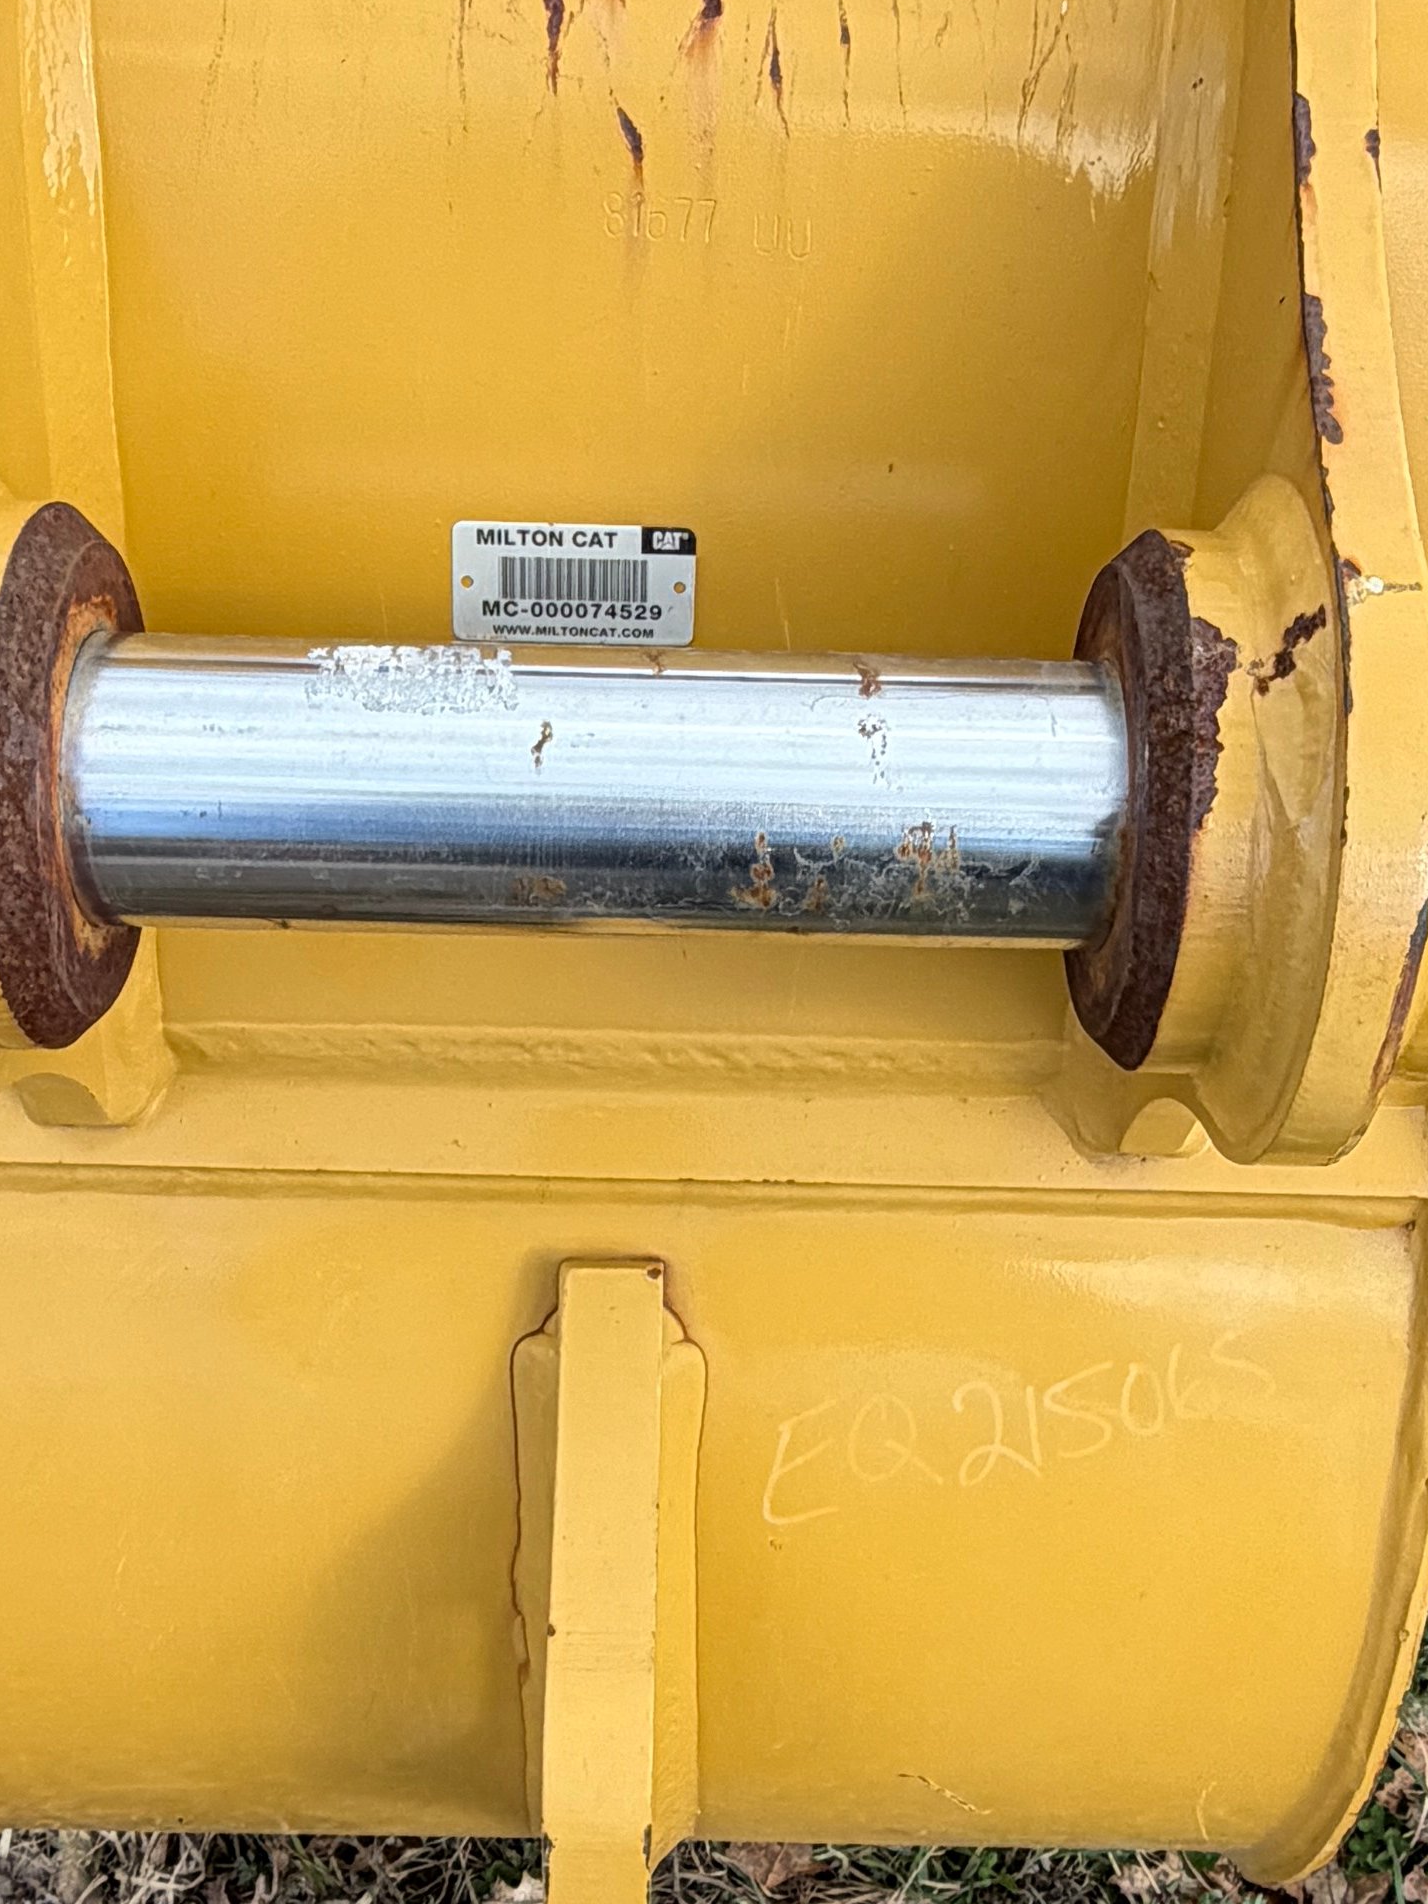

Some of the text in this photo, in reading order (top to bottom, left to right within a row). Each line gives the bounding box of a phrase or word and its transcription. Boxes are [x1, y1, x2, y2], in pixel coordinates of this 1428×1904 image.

[475, 528, 619, 548] MILTON CAT
[481, 600, 663, 621] MC-000074529
[492, 624, 655, 639] WWW.MILTONCAT.COM
